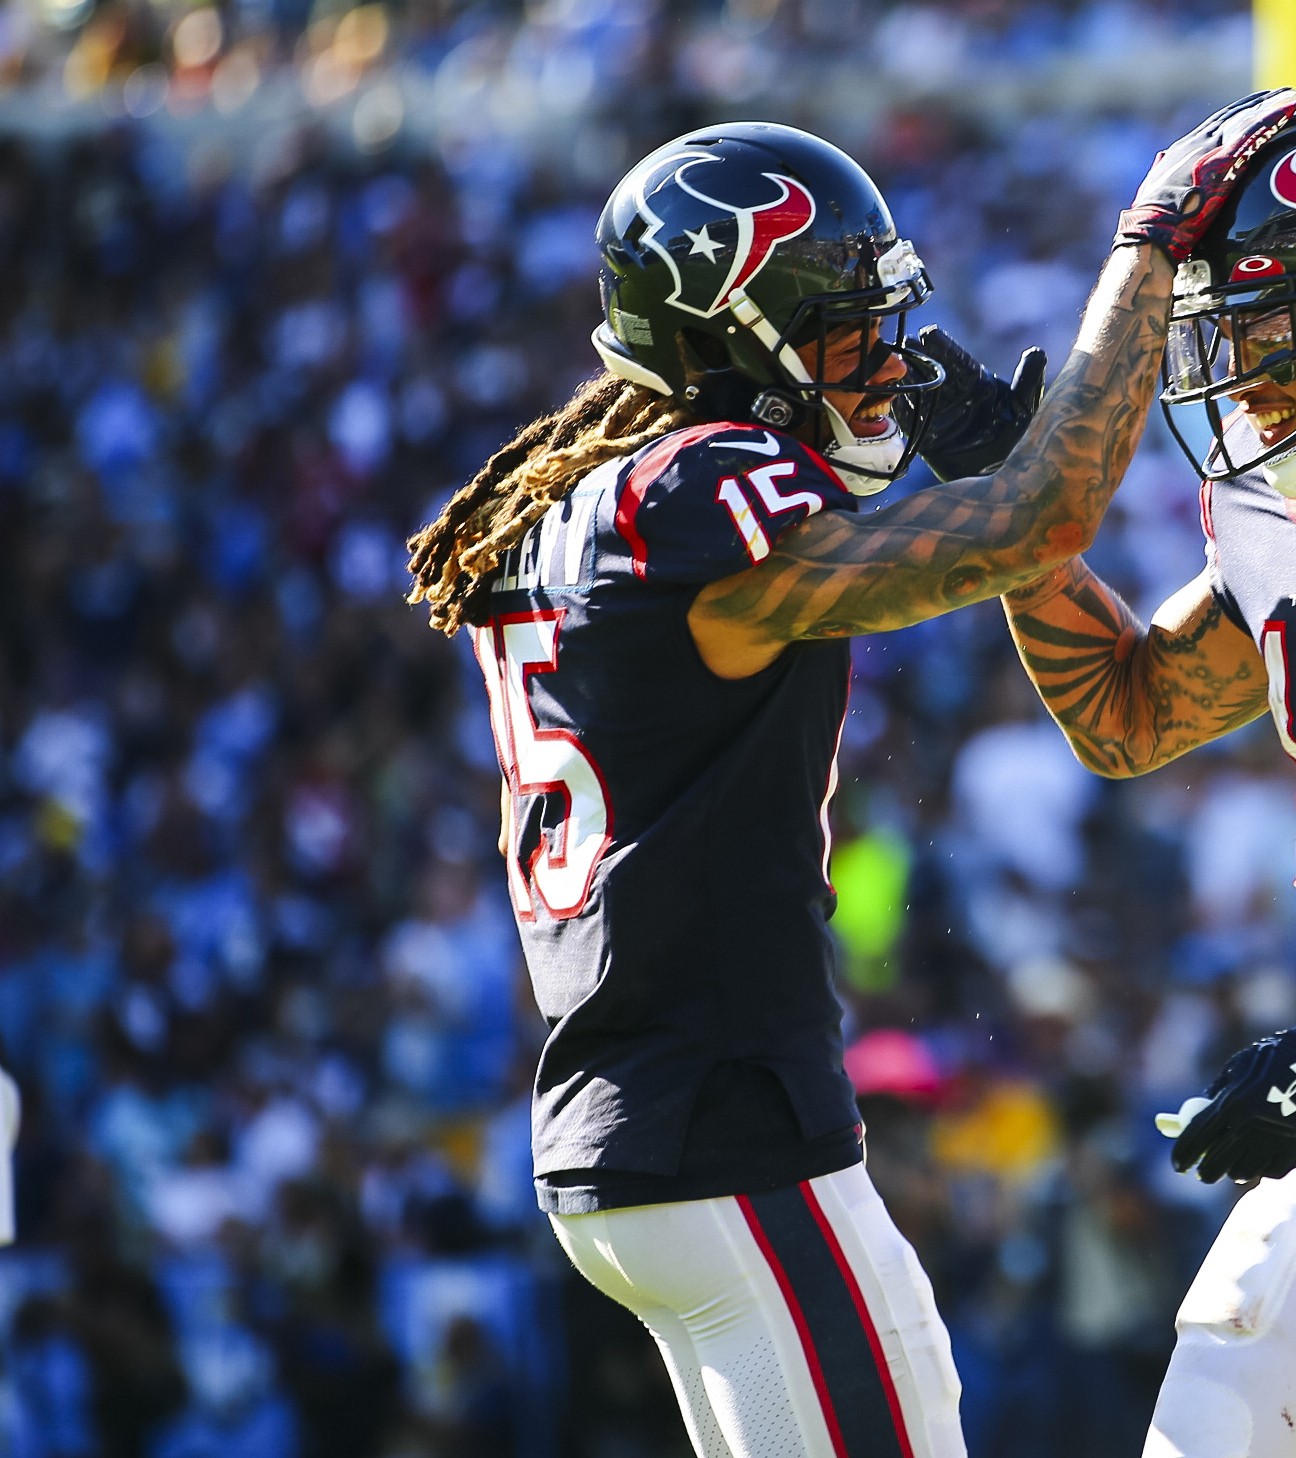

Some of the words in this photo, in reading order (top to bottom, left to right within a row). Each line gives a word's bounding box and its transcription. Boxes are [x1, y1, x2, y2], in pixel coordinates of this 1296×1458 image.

[1223, 115, 1289, 181] TEXANS
[716, 460, 826, 565] 15
[474, 608, 614, 922] 15
